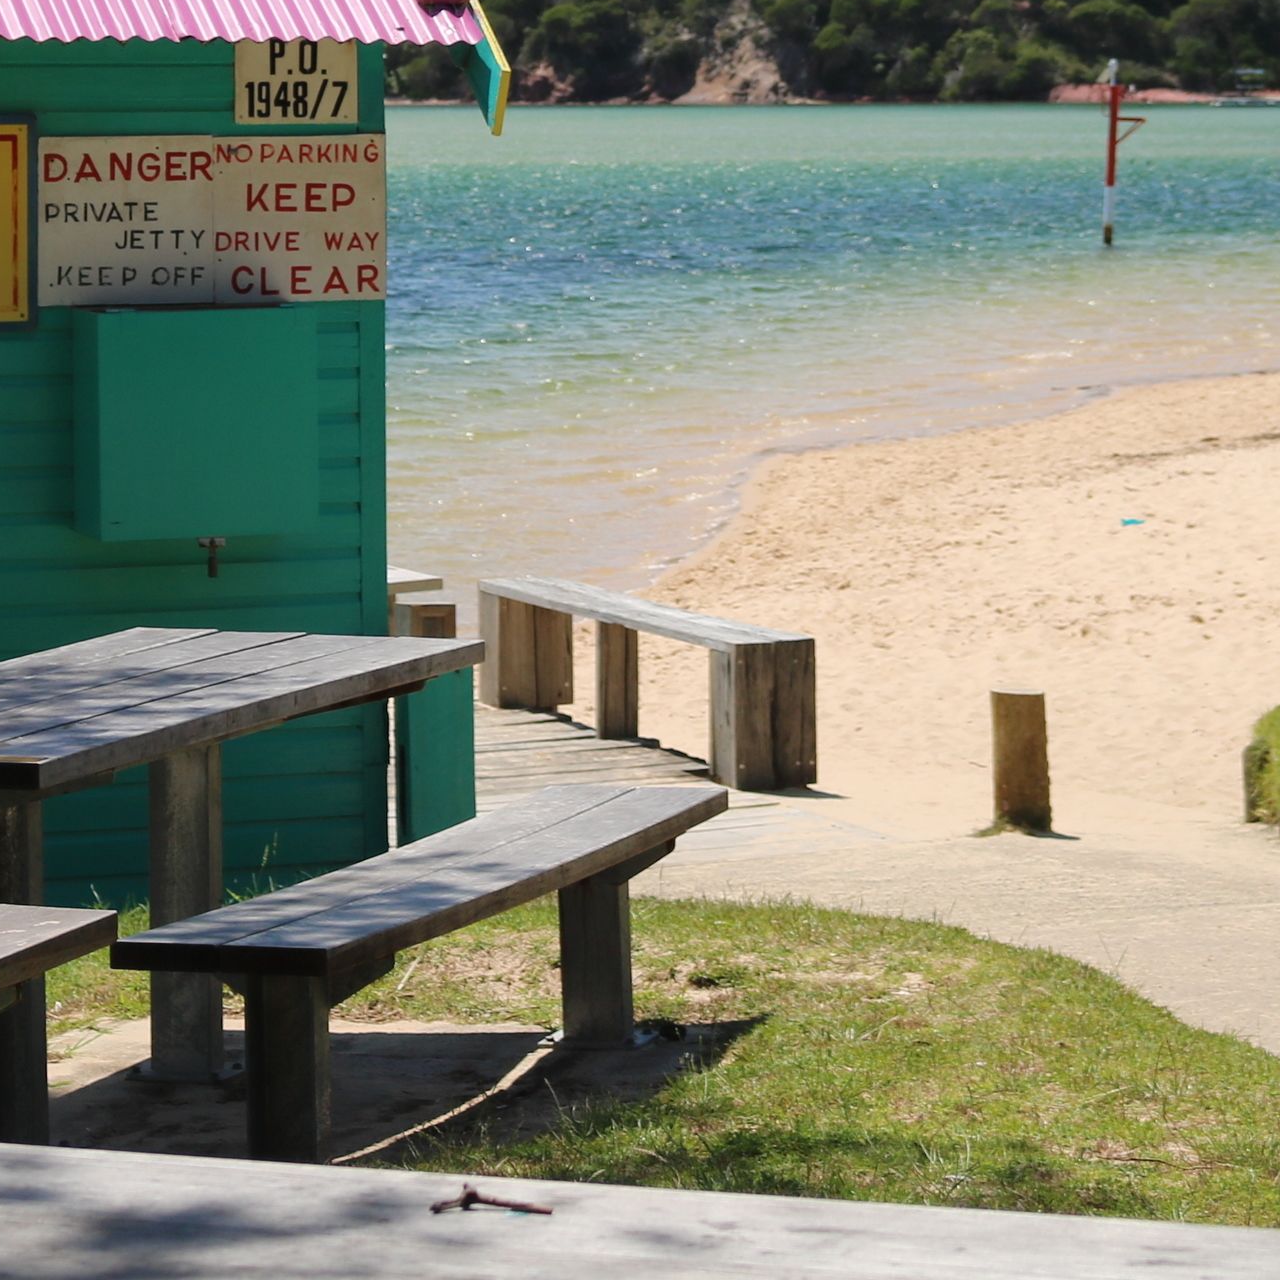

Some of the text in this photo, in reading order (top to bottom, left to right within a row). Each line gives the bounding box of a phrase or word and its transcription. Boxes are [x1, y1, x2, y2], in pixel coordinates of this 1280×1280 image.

[270, 38, 327, 76] P.O.
[244, 78, 348, 119] 1948/7
[43, 151, 214, 183] DANGER
[246, 183, 356, 212] KEEP
[44, 202, 158, 223] PRIVATE
[115, 229, 205, 250] JETTY
[215, 231, 380, 252] DRIVE WAY
[57, 266, 205, 287] KEEP OFF
[231, 264, 380, 296] CLEAR
